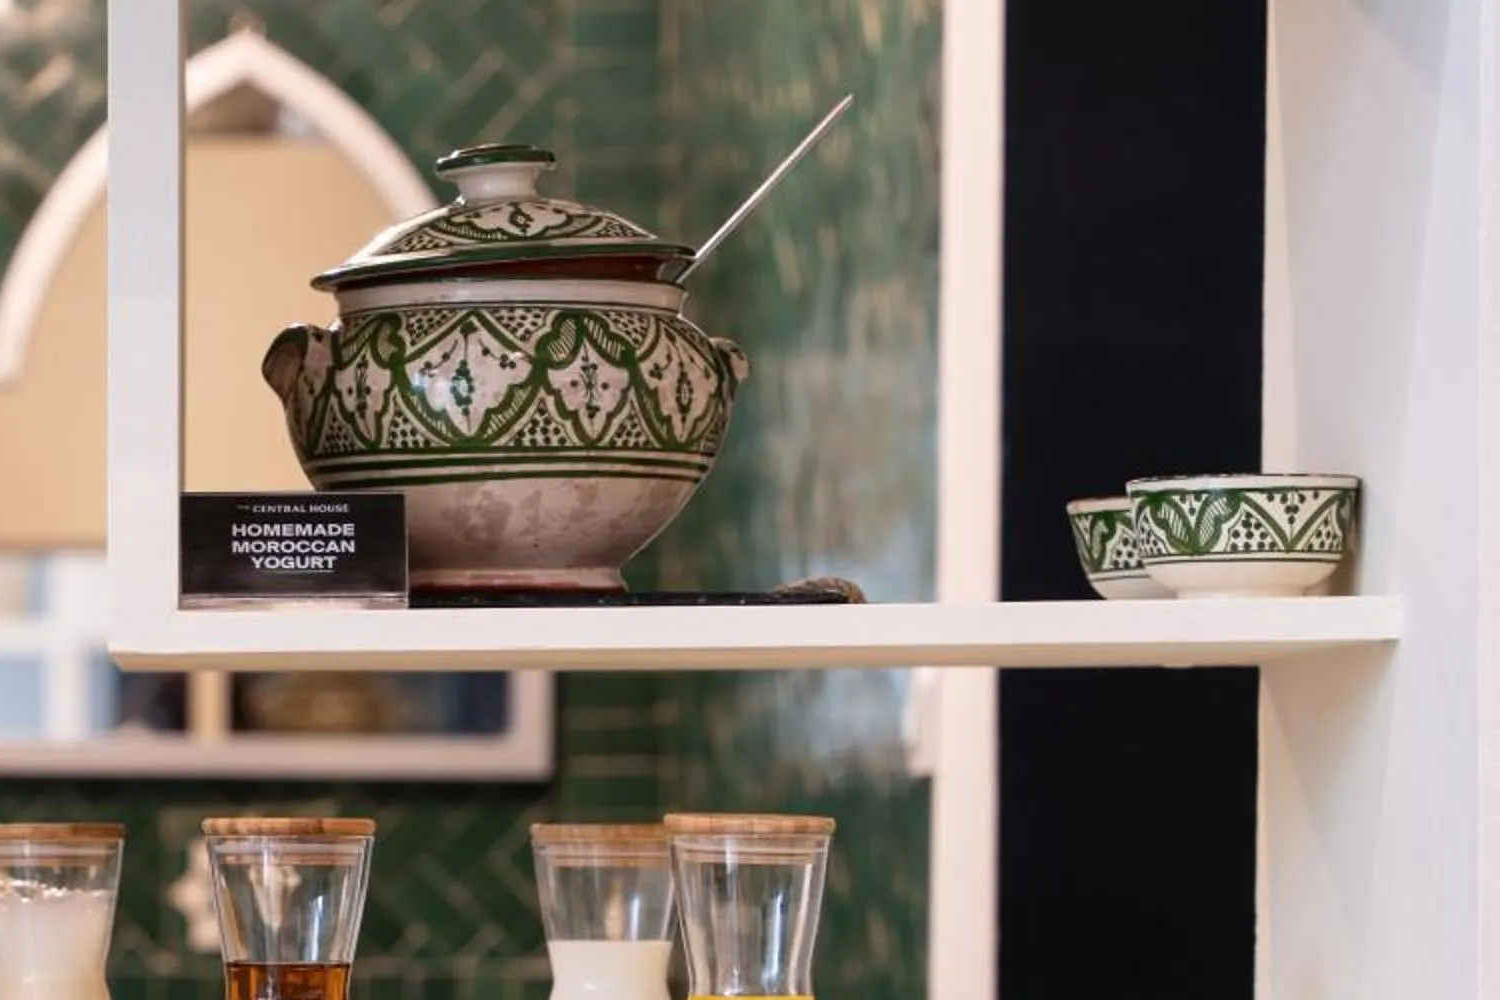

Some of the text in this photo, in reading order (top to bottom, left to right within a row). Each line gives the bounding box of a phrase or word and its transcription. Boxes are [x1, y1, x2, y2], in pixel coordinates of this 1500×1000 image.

[252, 503, 306, 513] CENTRAL
[309, 503, 350, 513] HOUSE
[231, 523, 355, 537] HOMEMADE
[231, 540, 355, 553] MOROCCAN
[251, 556, 337, 569] YOGURT
